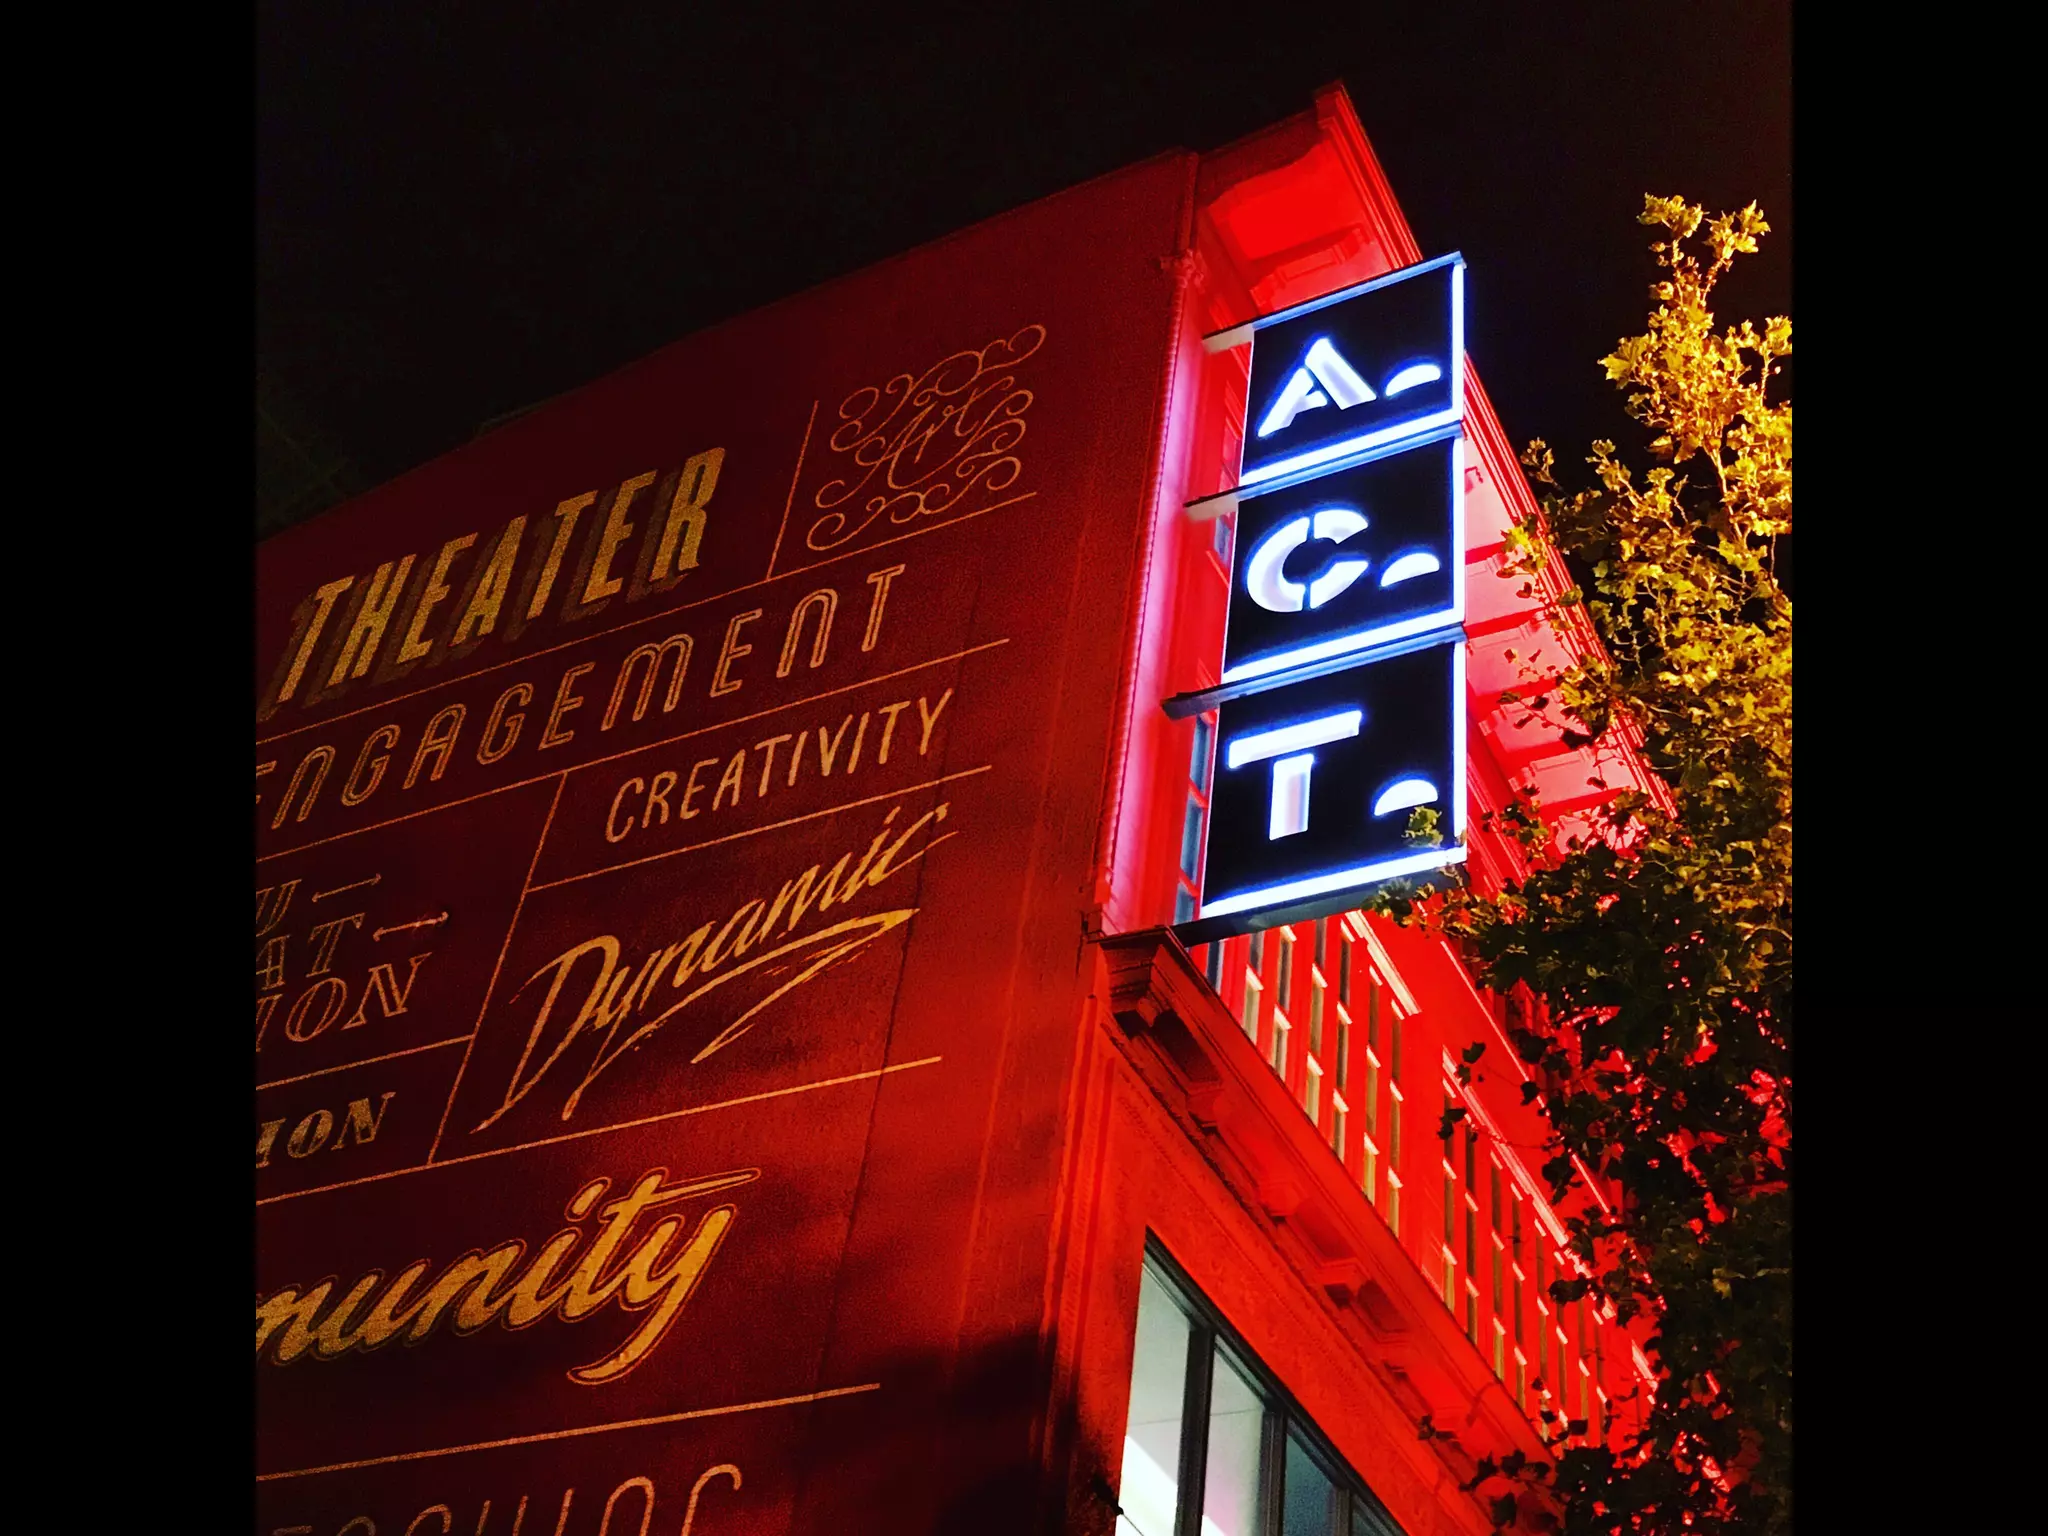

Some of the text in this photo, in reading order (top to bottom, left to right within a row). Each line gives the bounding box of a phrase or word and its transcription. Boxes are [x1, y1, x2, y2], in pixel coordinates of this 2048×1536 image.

[274, 446, 727, 703] THEATER
[604, 687, 955, 844] CREATIVITY
[469, 802, 959, 1134] Dynamic
[256, 1090, 397, 1169] ION
